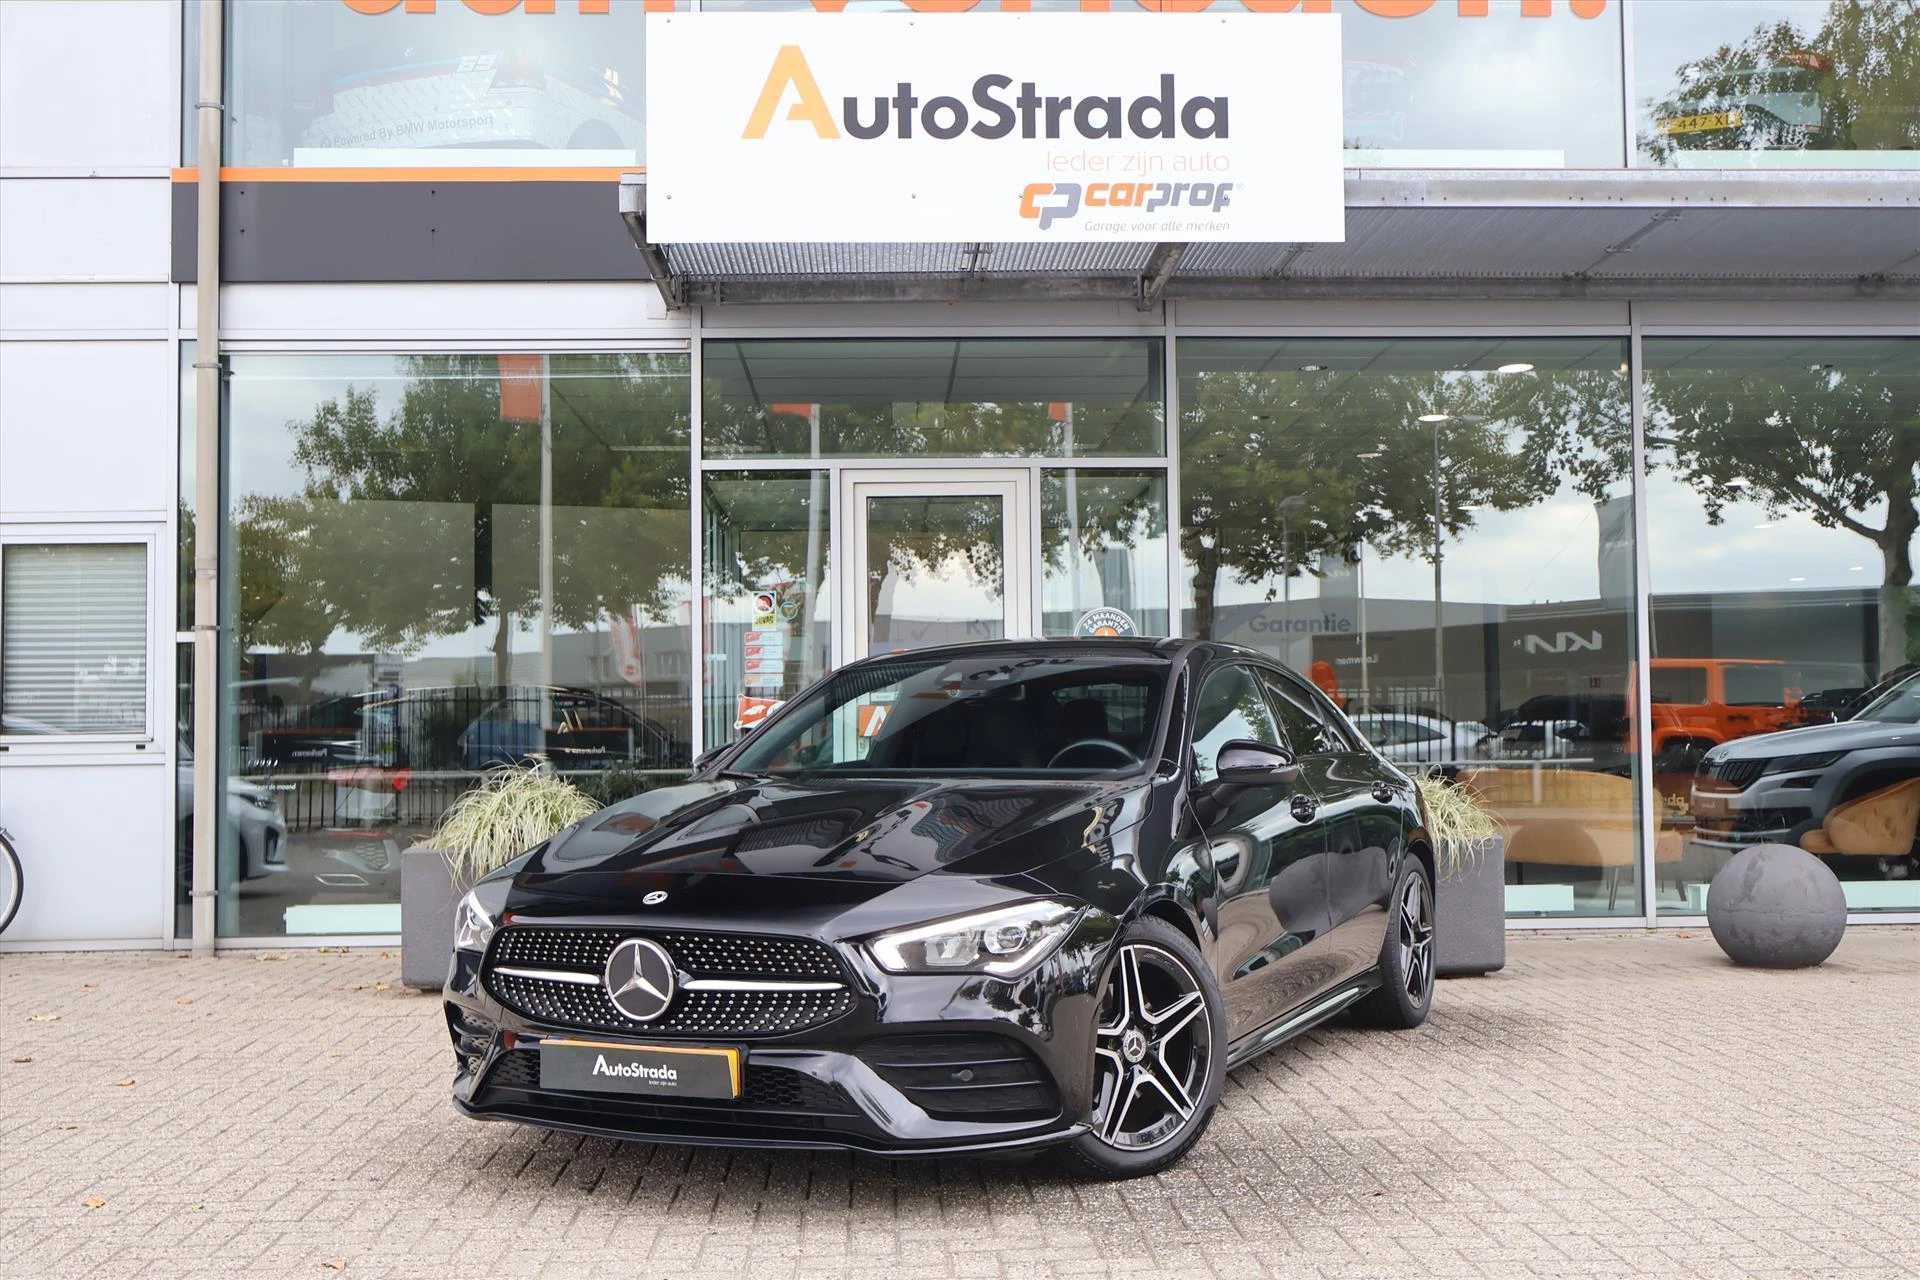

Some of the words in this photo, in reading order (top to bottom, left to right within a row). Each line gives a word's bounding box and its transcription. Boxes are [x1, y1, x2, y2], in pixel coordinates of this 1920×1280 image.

[741, 45, 1229, 139] AutoStrada
[333, 127, 376, 147] Powered
[380, 127, 393, 139] By
[396, 122, 424, 137] BMW
[428, 115, 495, 132] Motorsport
[1047, 151, 1114, 172] Ieder
[1122, 151, 1162, 177] zijn
[1172, 152, 1230, 172] auto
[1084, 182, 1233, 212] carprof
[1085, 220, 1127, 234] Garage
[1131, 222, 1157, 232] voor
[1160, 220, 1182, 232] alle
[1186, 220, 1230, 232] merken
[1083, 619, 1093, 629] 24
[1092, 612, 1130, 630] MAANDEN
[1089, 619, 1124, 634] GARANTIE
[1249, 613, 1352, 633] Garantie
[592, 1054, 678, 1080] AutoStrada
